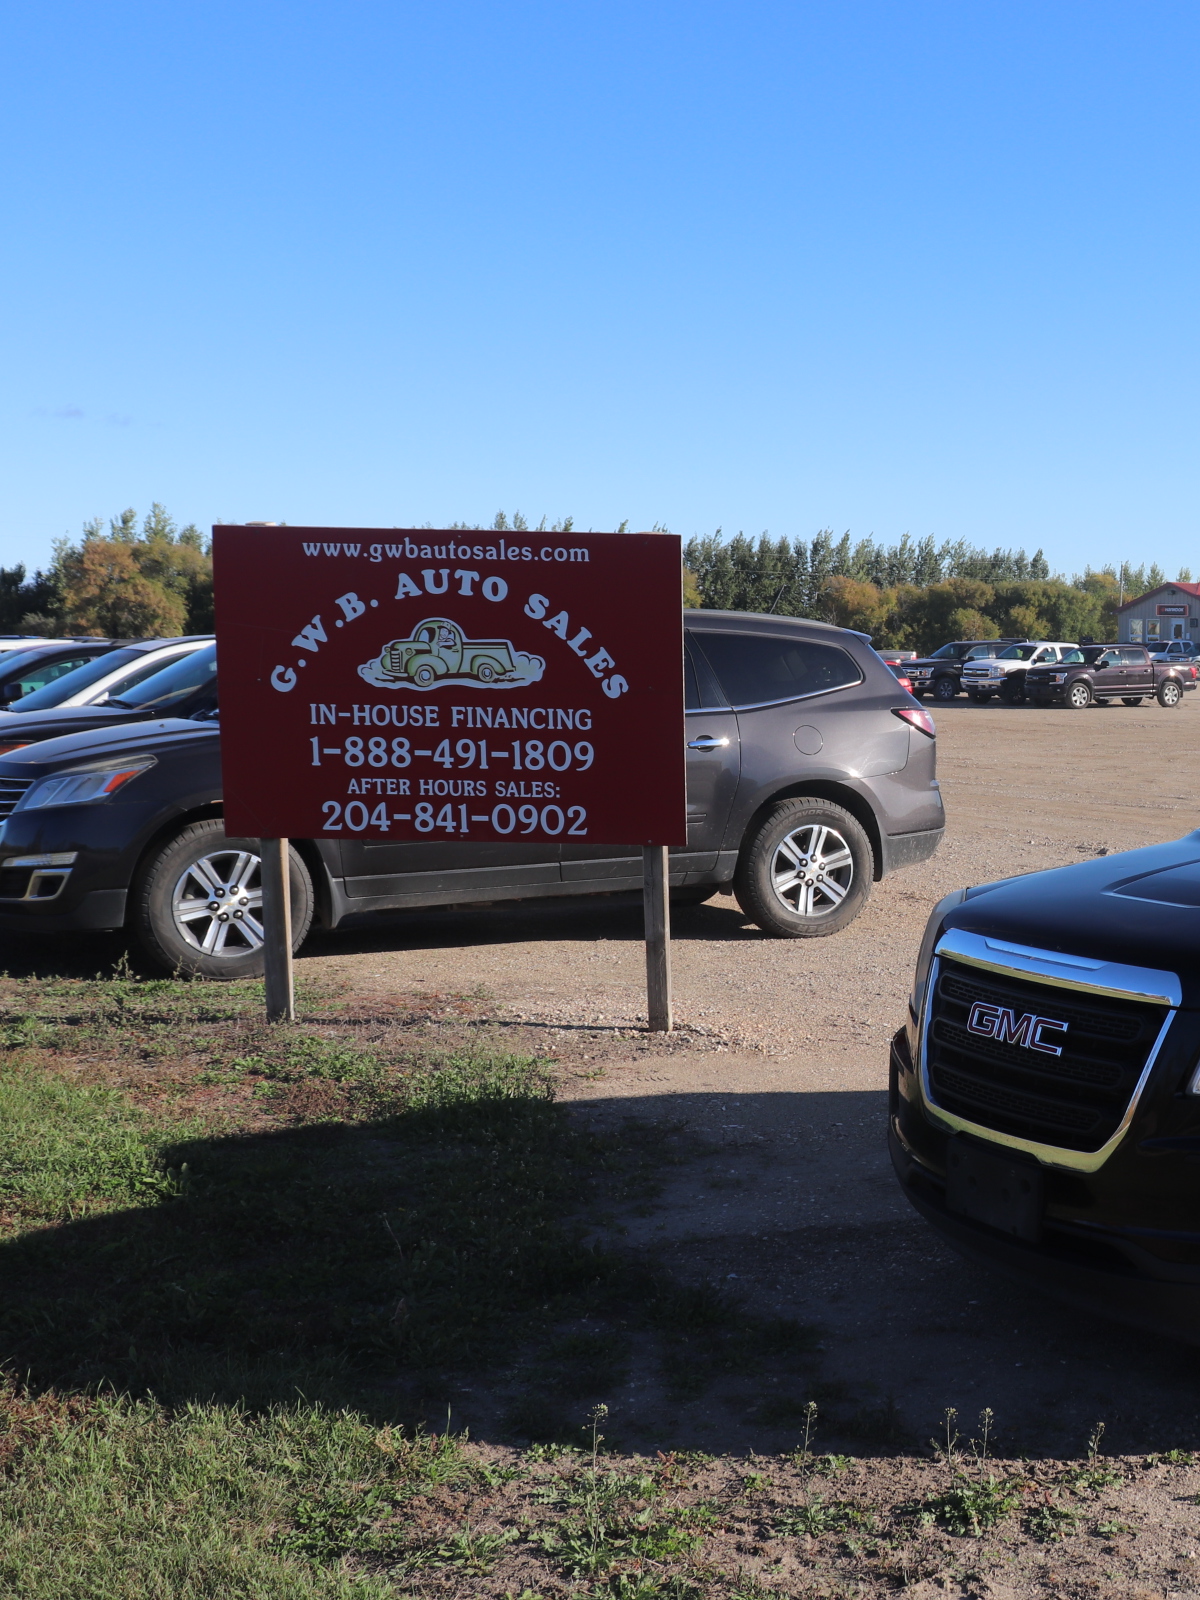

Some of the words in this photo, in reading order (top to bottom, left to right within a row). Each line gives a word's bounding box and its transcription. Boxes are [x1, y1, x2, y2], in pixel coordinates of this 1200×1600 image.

[302, 536, 590, 562] www.gwbautosales.com
[270, 592, 379, 692] G.W.B.
[395, 569, 508, 602] AUTO
[524, 593, 629, 699] SALES
[310, 704, 439, 727] IN-HOUSE
[451, 707, 592, 730] FINANCING
[310, 737, 595, 771] 1-888-491-1809
[347, 778, 411, 796] AFTER
[419, 779, 487, 797] HOURS
[495, 781, 561, 798] SALES:
[322, 800, 588, 836] 204-841-0902
[967, 1001, 1069, 1057] GMC
